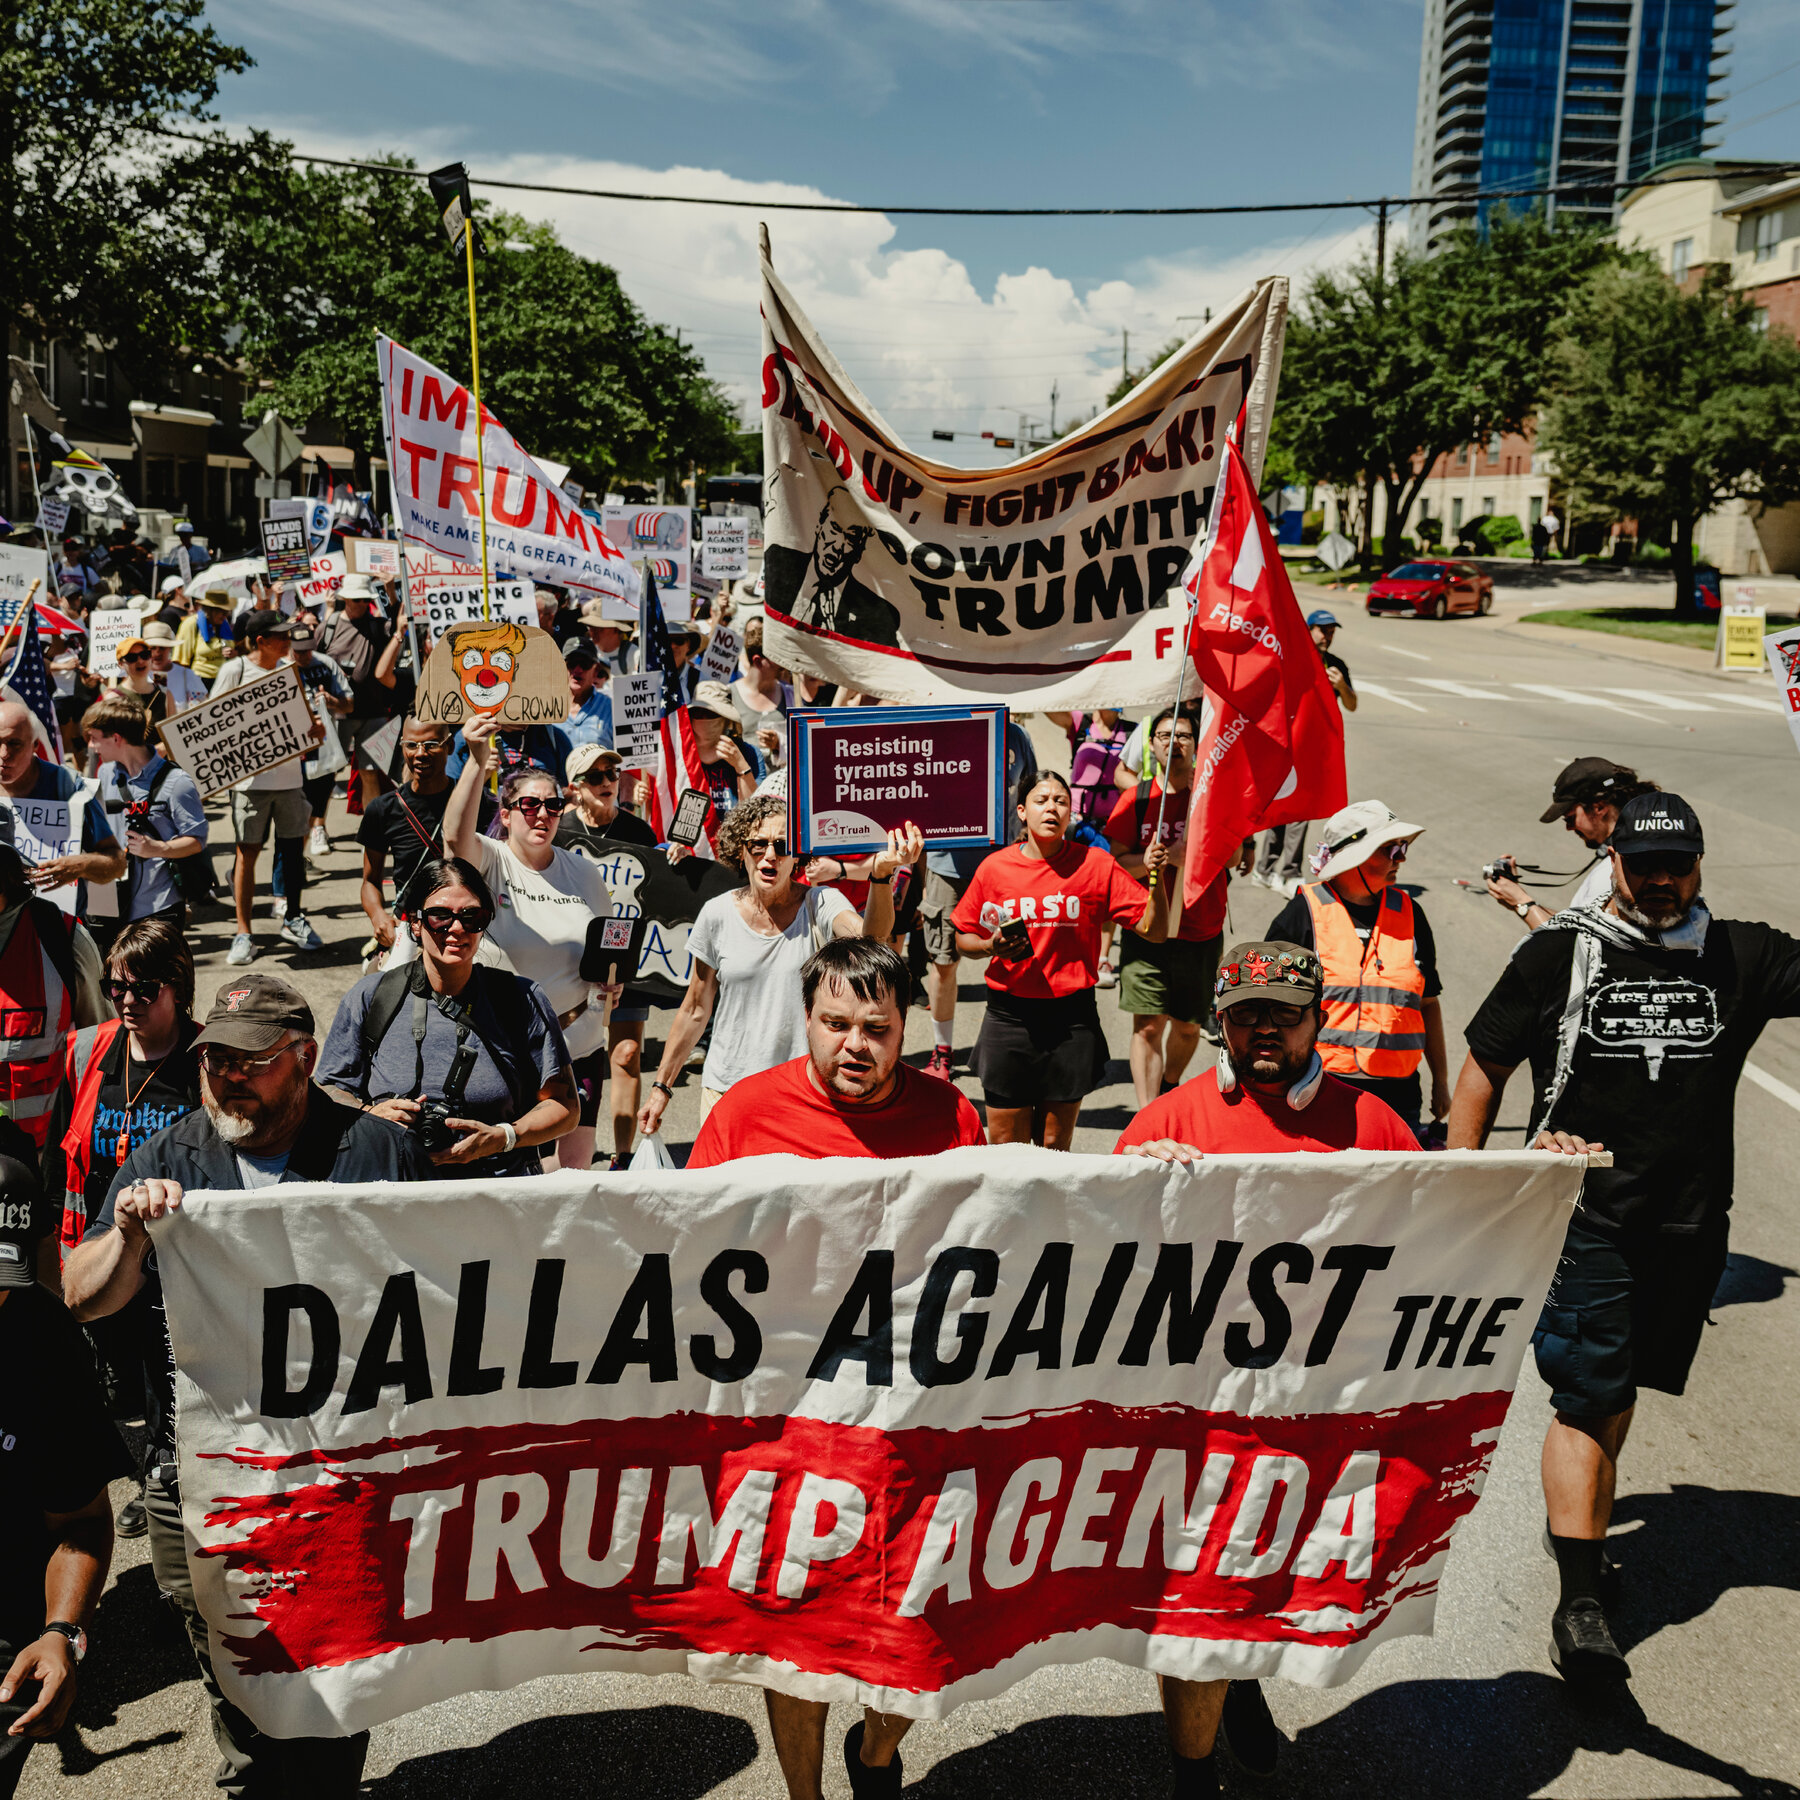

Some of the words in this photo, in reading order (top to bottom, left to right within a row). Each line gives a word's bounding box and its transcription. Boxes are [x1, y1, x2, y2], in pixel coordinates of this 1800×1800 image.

[862, 449, 924, 525] UP,
[943, 470, 1086, 528] FIGHT
[1086, 404, 1217, 504] BACK!
[400, 436, 625, 561] TRUMP
[264, 520, 302, 534] HANDS
[718, 521, 733, 530] I'M
[1080, 485, 1216, 560] WITH
[266, 532, 304, 551] OFF!
[411, 510, 439, 534] MAKE
[522, 545, 578, 569] GREAT
[582, 559, 625, 586] AGAIN
[707, 536, 744, 544] AGAINST
[707, 547, 745, 555] TRUMP'S
[908, 545, 1194, 638] TRUMP
[107, 615, 123, 624] I'M
[429, 606, 457, 621] OR
[95, 630, 135, 640] AGAINST
[714, 629, 734, 648] NO
[711, 644, 737, 663] TRUMP'S
[706, 657, 732, 676] WAR
[631, 680, 649, 692] WE
[176, 713, 203, 734] HEY
[209, 675, 287, 719] CONGRESS
[503, 694, 564, 722] CROWN
[624, 692, 656, 706] DON'T
[182, 710, 246, 748] PROJECT
[253, 684, 299, 716] 2027
[625, 706, 657, 719] WANT
[632, 722, 653, 733] WAR
[632, 733, 655, 744] WITH
[835, 736, 934, 758] Resisting
[632, 743, 655, 755] IRAN
[834, 760, 908, 784] tyrants
[913, 757, 972, 777] since
[835, 780, 929, 803] Pharaoh.
[12, 805, 68, 828] BIBLE
[1634, 818, 1685, 832] UNION
[925, 825, 983, 836] www.truah.org
[1003, 894, 1080, 921] FRSO
[1600, 1017, 1708, 1036] TEXAS
[259, 1248, 770, 1420] DALLAS
[804, 1239, 1397, 1389] AGAINST
[1383, 1294, 1524, 1373] THE
[389, 1464, 867, 1621] TRUMP
[896, 1446, 1381, 1618] AGENDA
